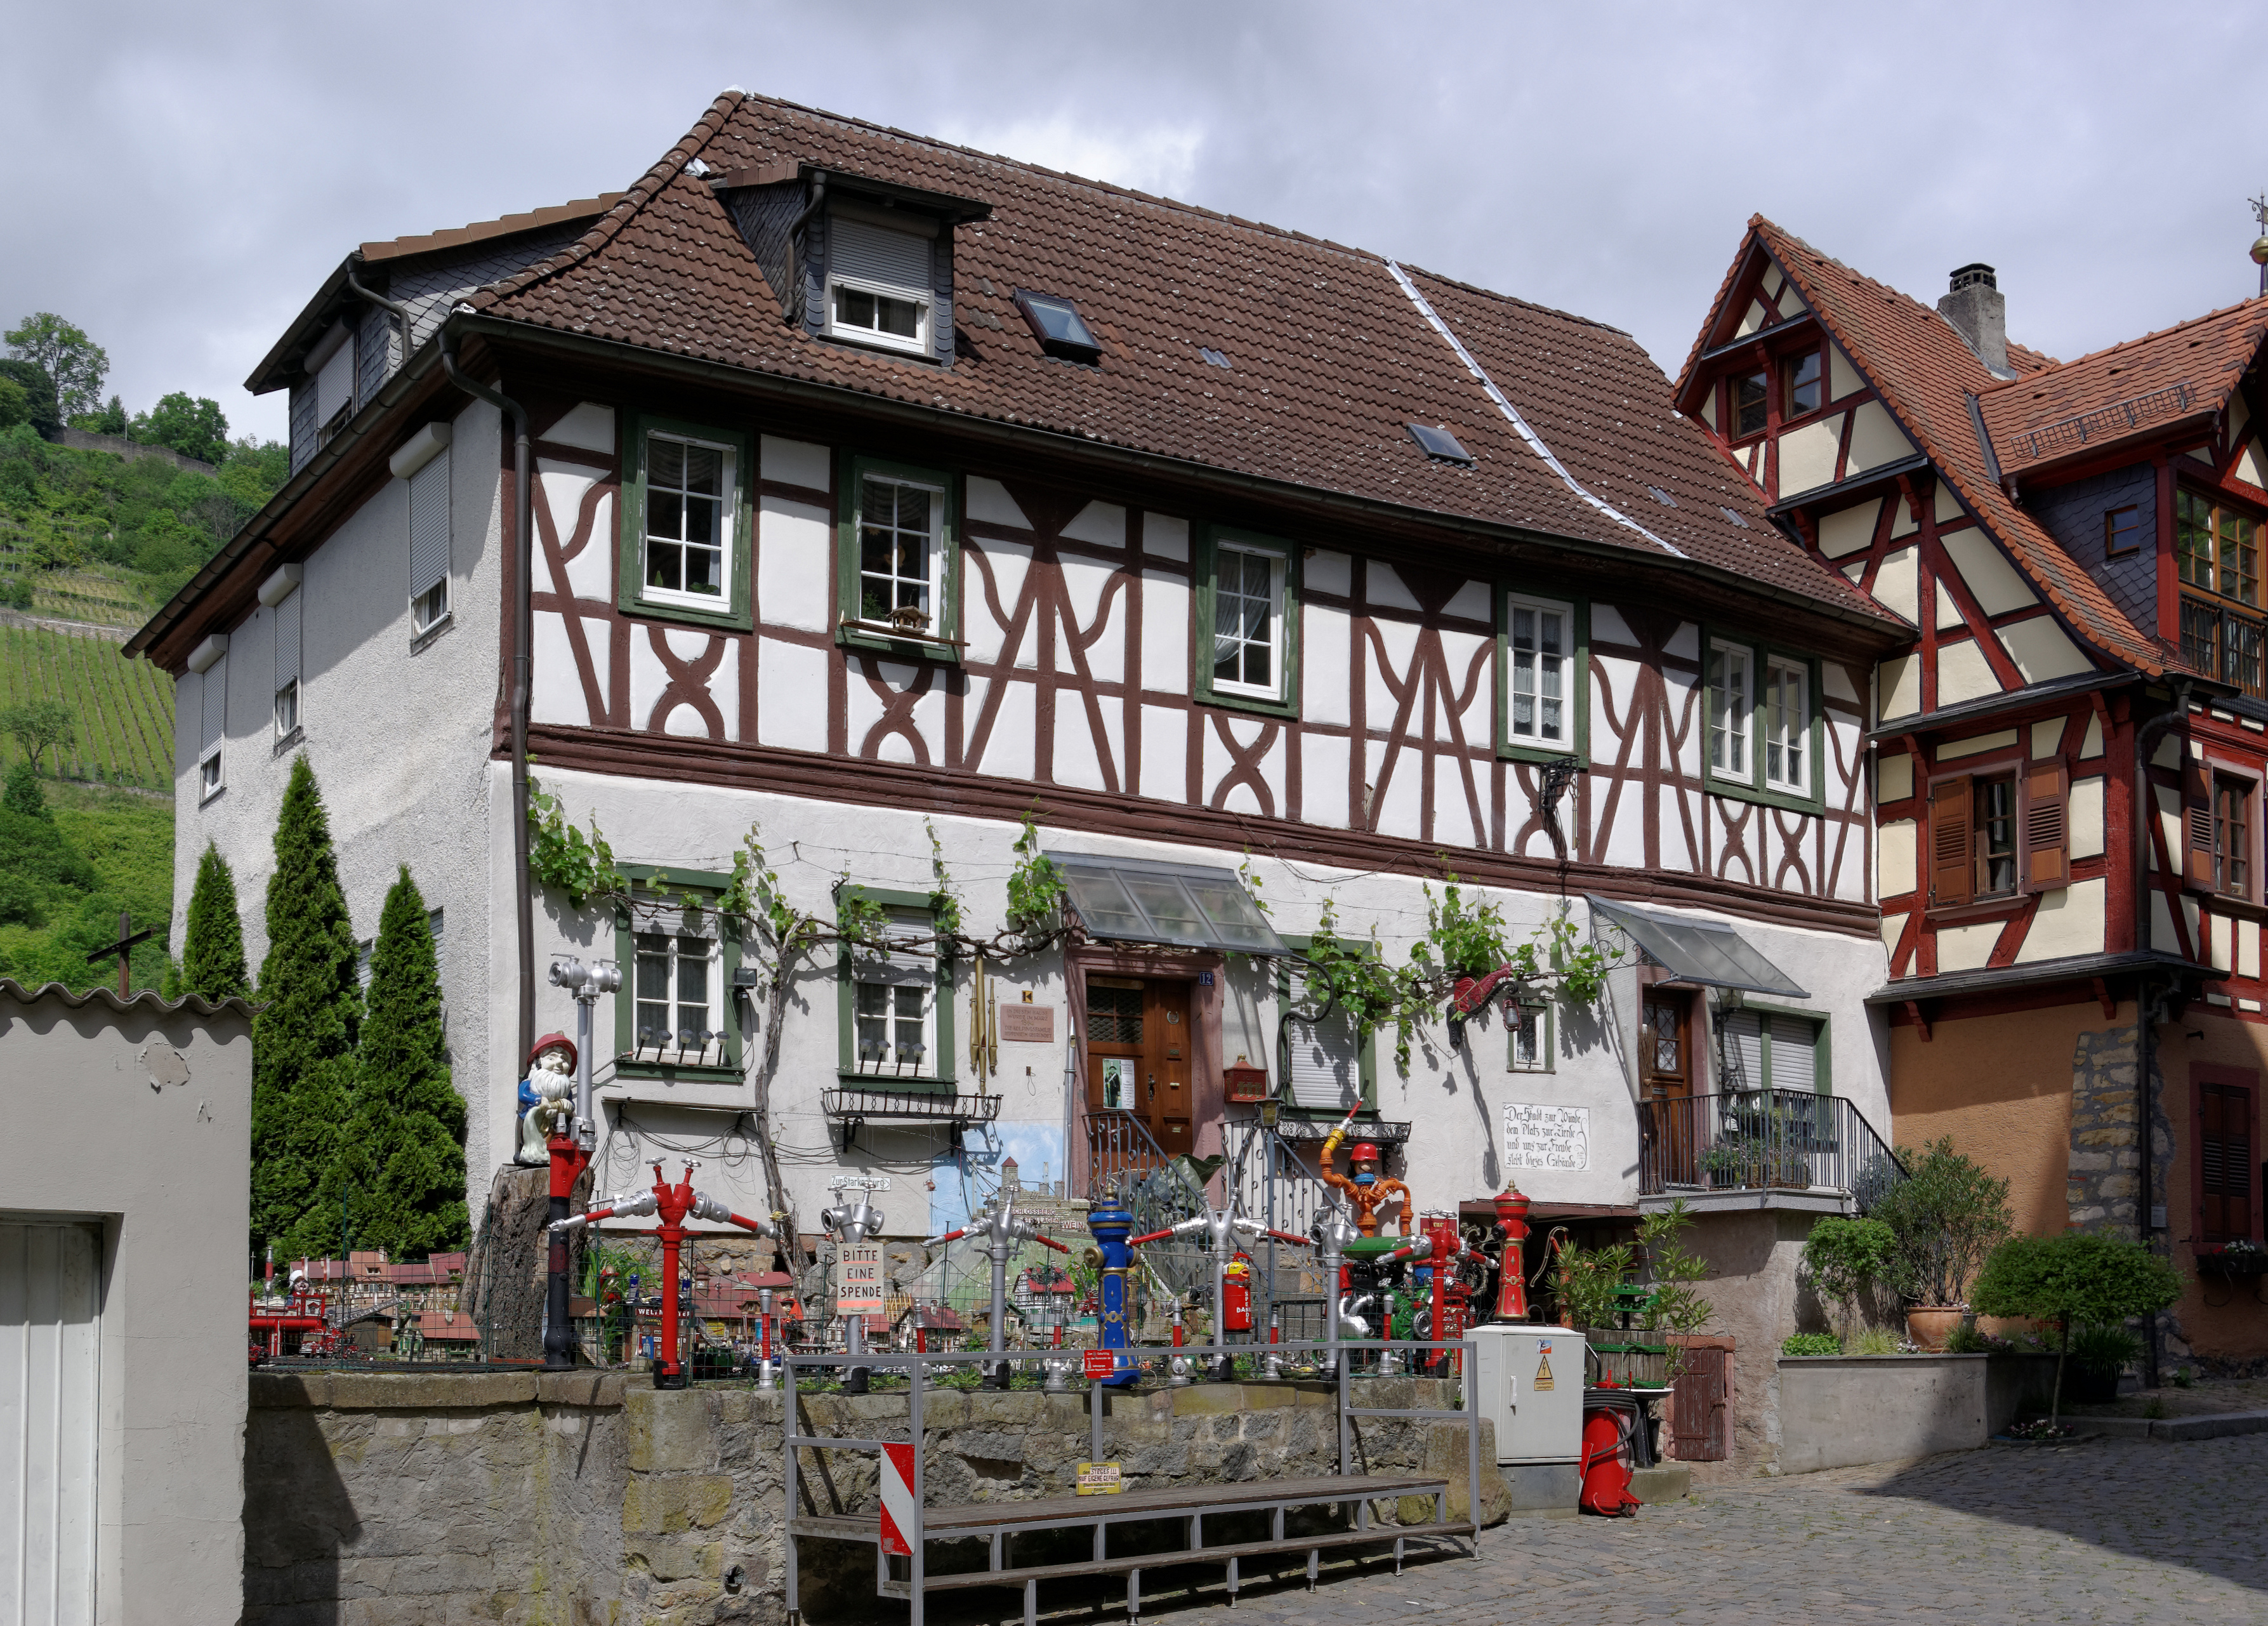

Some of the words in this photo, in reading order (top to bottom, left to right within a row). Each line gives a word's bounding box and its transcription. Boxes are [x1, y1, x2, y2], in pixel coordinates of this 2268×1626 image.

[1202, 974, 1211, 984] 12
[1504, 1105, 1523, 1121] Der
[1520, 1105, 1541, 1123] Stadt
[1545, 1114, 1556, 1123] zur
[1557, 1108, 1580, 1123] Würde
[1507, 1122, 1518, 1135] dem
[1522, 1123, 1539, 1137] Platz
[1541, 1128, 1553, 1137] zur
[1553, 1123, 1575, 1138] Zierde
[1507, 1137, 1519, 1149] und
[1523, 1141, 1535, 1151] uns
[1536, 1142, 1547, 1152] zur
[1548, 1139, 1571, 1152] Freude
[1547, 1153, 1576, 1167] Gebäude
[843, 1250, 878, 1262] BITTE
[847, 1268, 874, 1279] EINE
[840, 1286, 881, 1297] SPENDE
